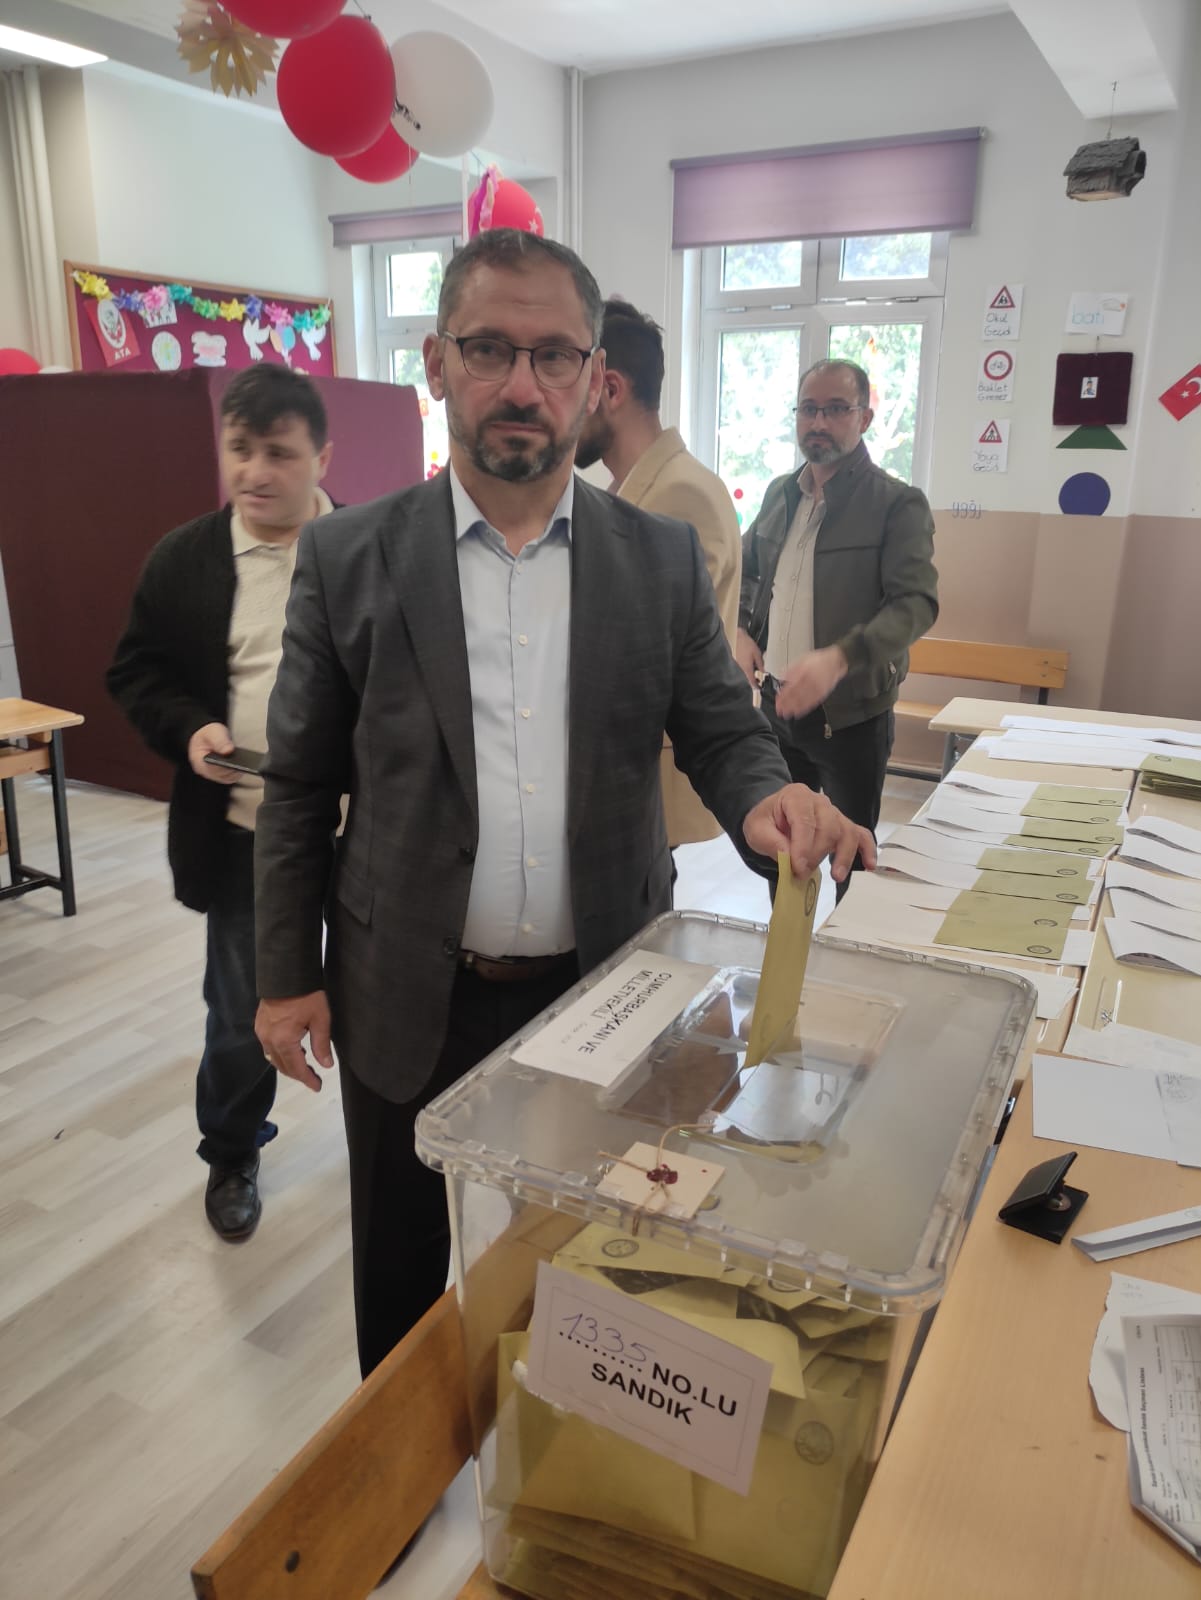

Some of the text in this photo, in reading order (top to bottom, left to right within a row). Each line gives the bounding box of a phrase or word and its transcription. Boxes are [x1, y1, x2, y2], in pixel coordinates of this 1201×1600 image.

[114, 347, 132, 361] ATA
[593, 973, 672, 1040] CUMHURBAŞKANI
[578, 1041, 601, 1054] VE
[590, 1362, 693, 1425] SANDIK
[651, 1362, 737, 1417] NO.LU
